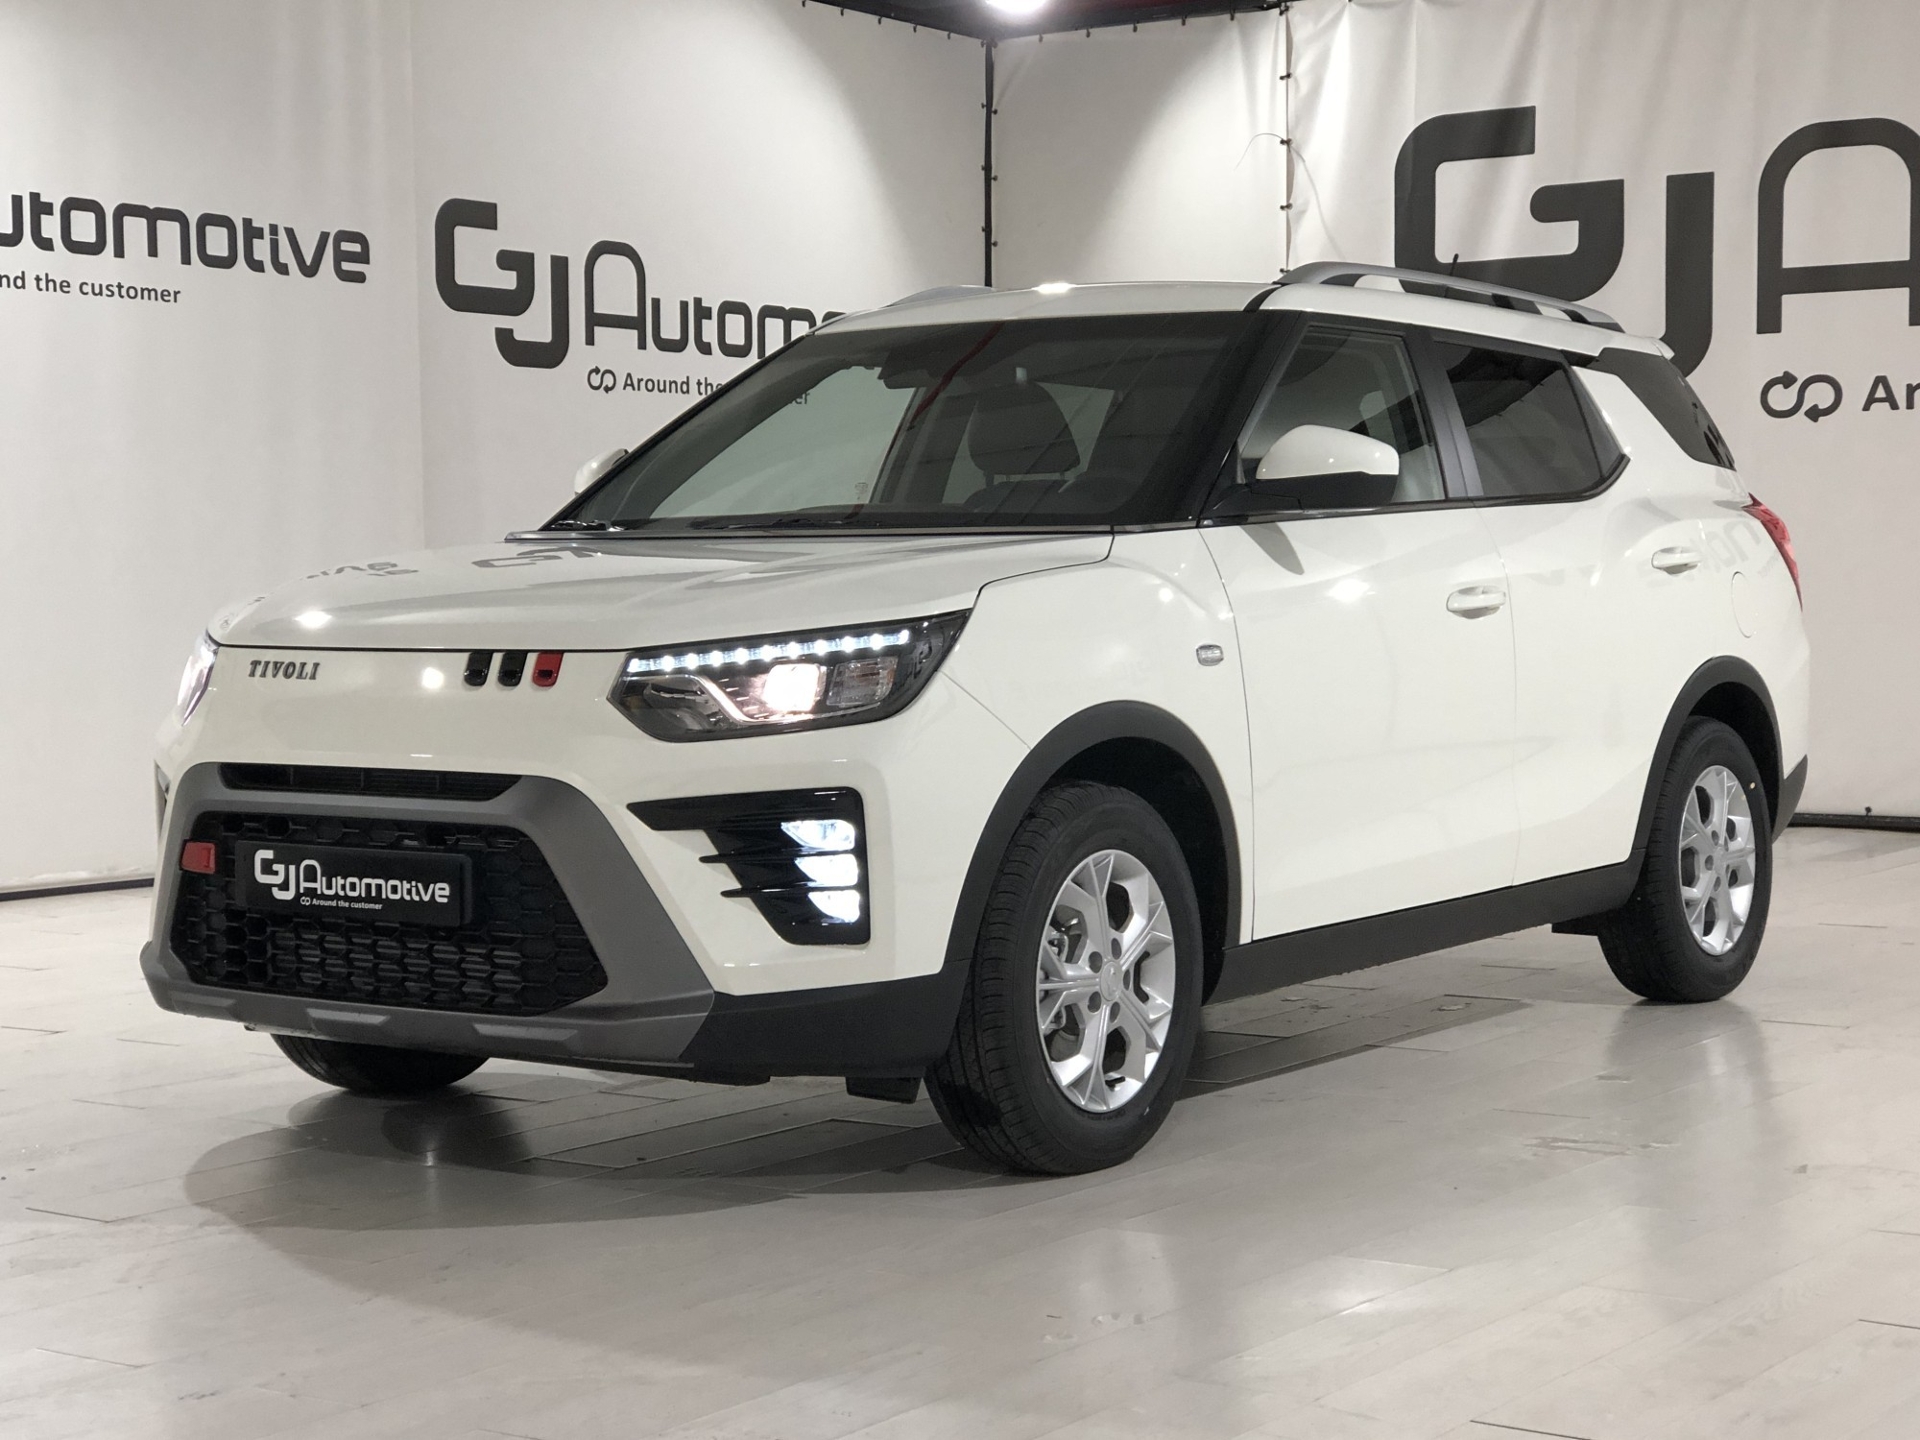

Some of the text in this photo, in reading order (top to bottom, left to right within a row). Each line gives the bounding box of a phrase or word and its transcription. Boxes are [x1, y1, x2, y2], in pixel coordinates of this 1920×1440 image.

[34, 272, 71, 294] the
[79, 281, 181, 304] customer
[623, 372, 690, 395] Around
[1862, 375, 1920, 412] Ar
[248, 659, 321, 681] TIVOLI
[312, 898, 383, 910] Around the customer
